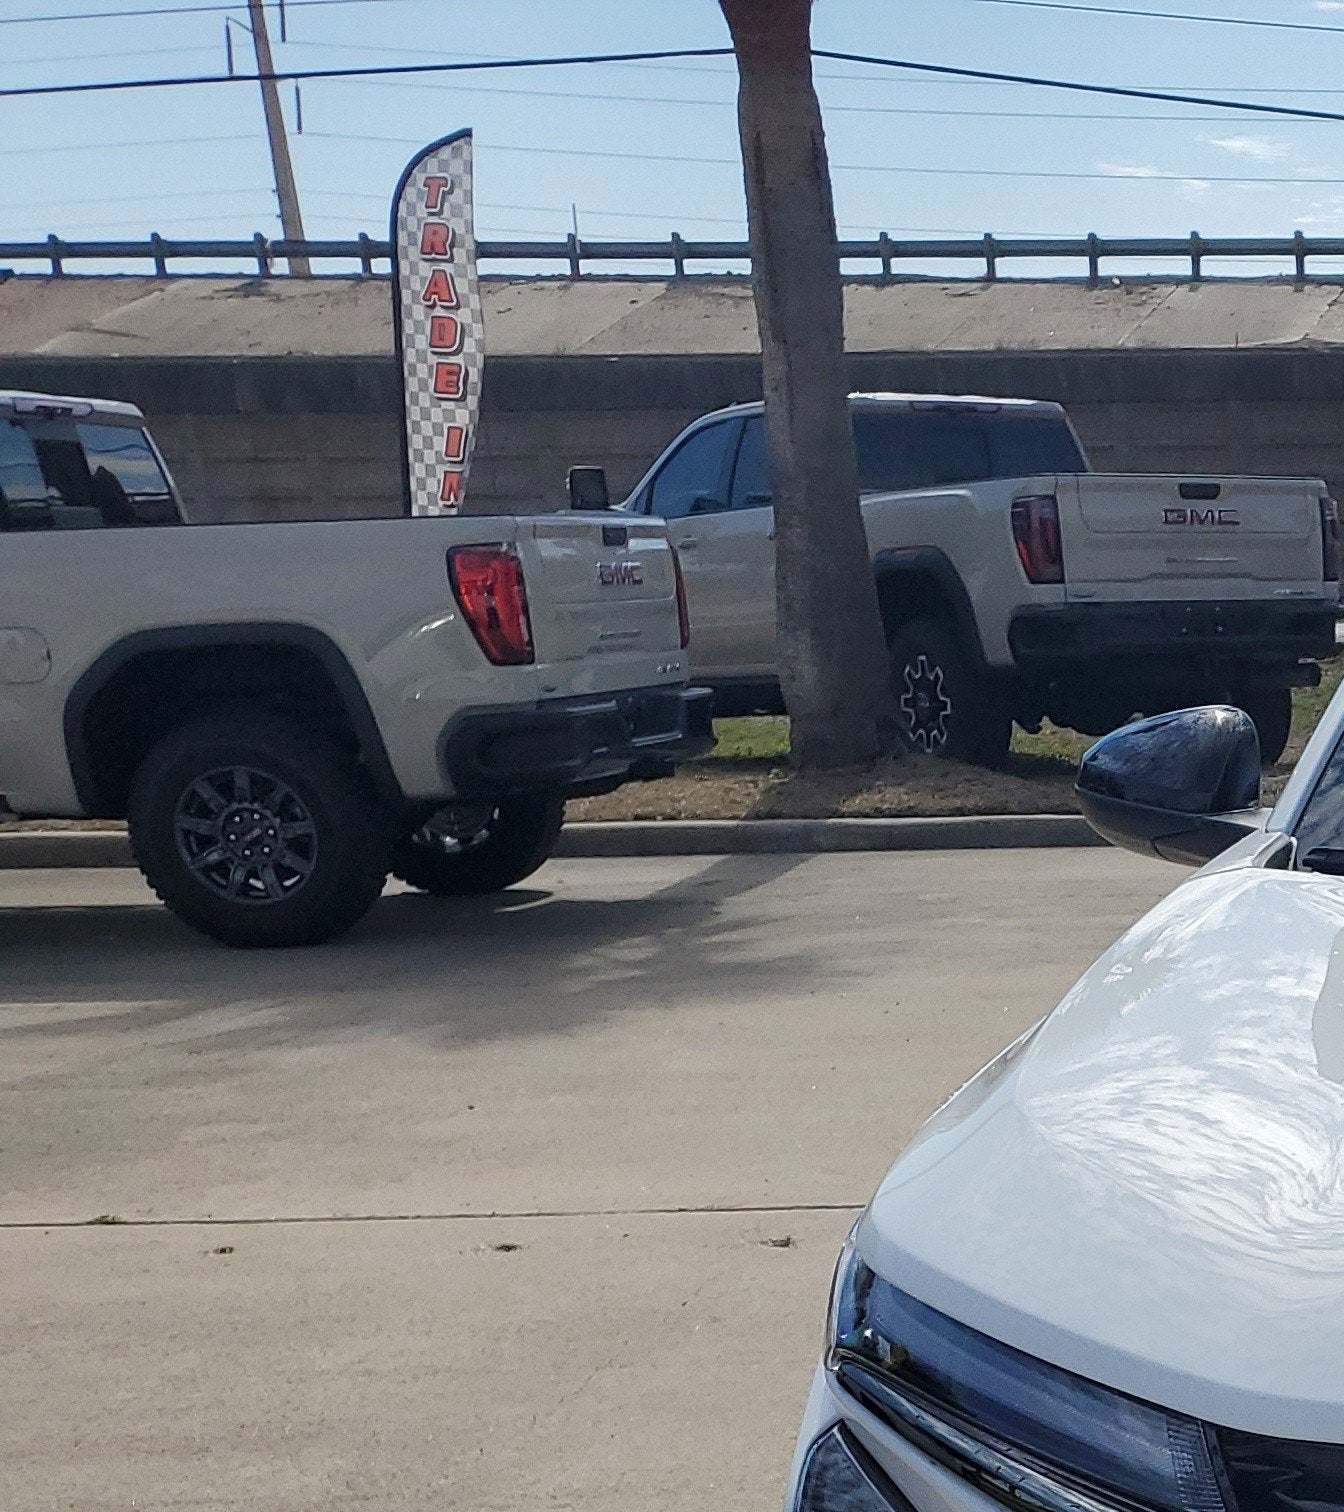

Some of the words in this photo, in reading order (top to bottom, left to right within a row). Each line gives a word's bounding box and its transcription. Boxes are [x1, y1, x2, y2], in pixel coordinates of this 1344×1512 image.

[420, 174, 465, 399] TRADE
[439, 423, 467, 506] IN
[1162, 509, 1240, 525] GMC
